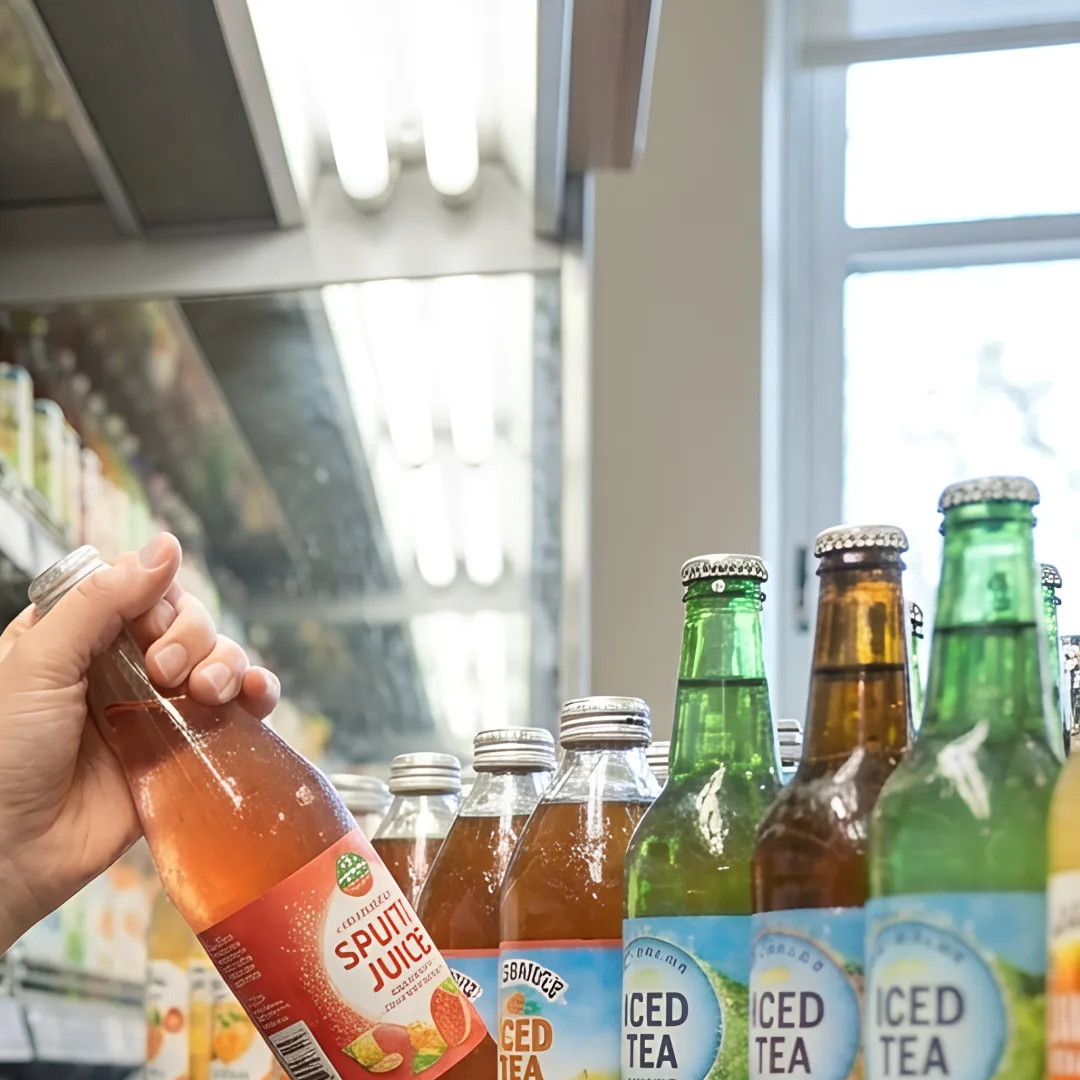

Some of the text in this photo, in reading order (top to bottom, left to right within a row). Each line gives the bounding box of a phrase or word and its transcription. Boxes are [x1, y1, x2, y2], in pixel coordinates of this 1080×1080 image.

[624, 991, 689, 1028] ICED
[752, 990, 825, 1030] ICED
[876, 985, 965, 1028] ICED
[501, 1018, 553, 1052] CED
[626, 1033, 678, 1069] TEA
[755, 1036, 812, 1075] TEA
[879, 1035, 951, 1077] TEA
